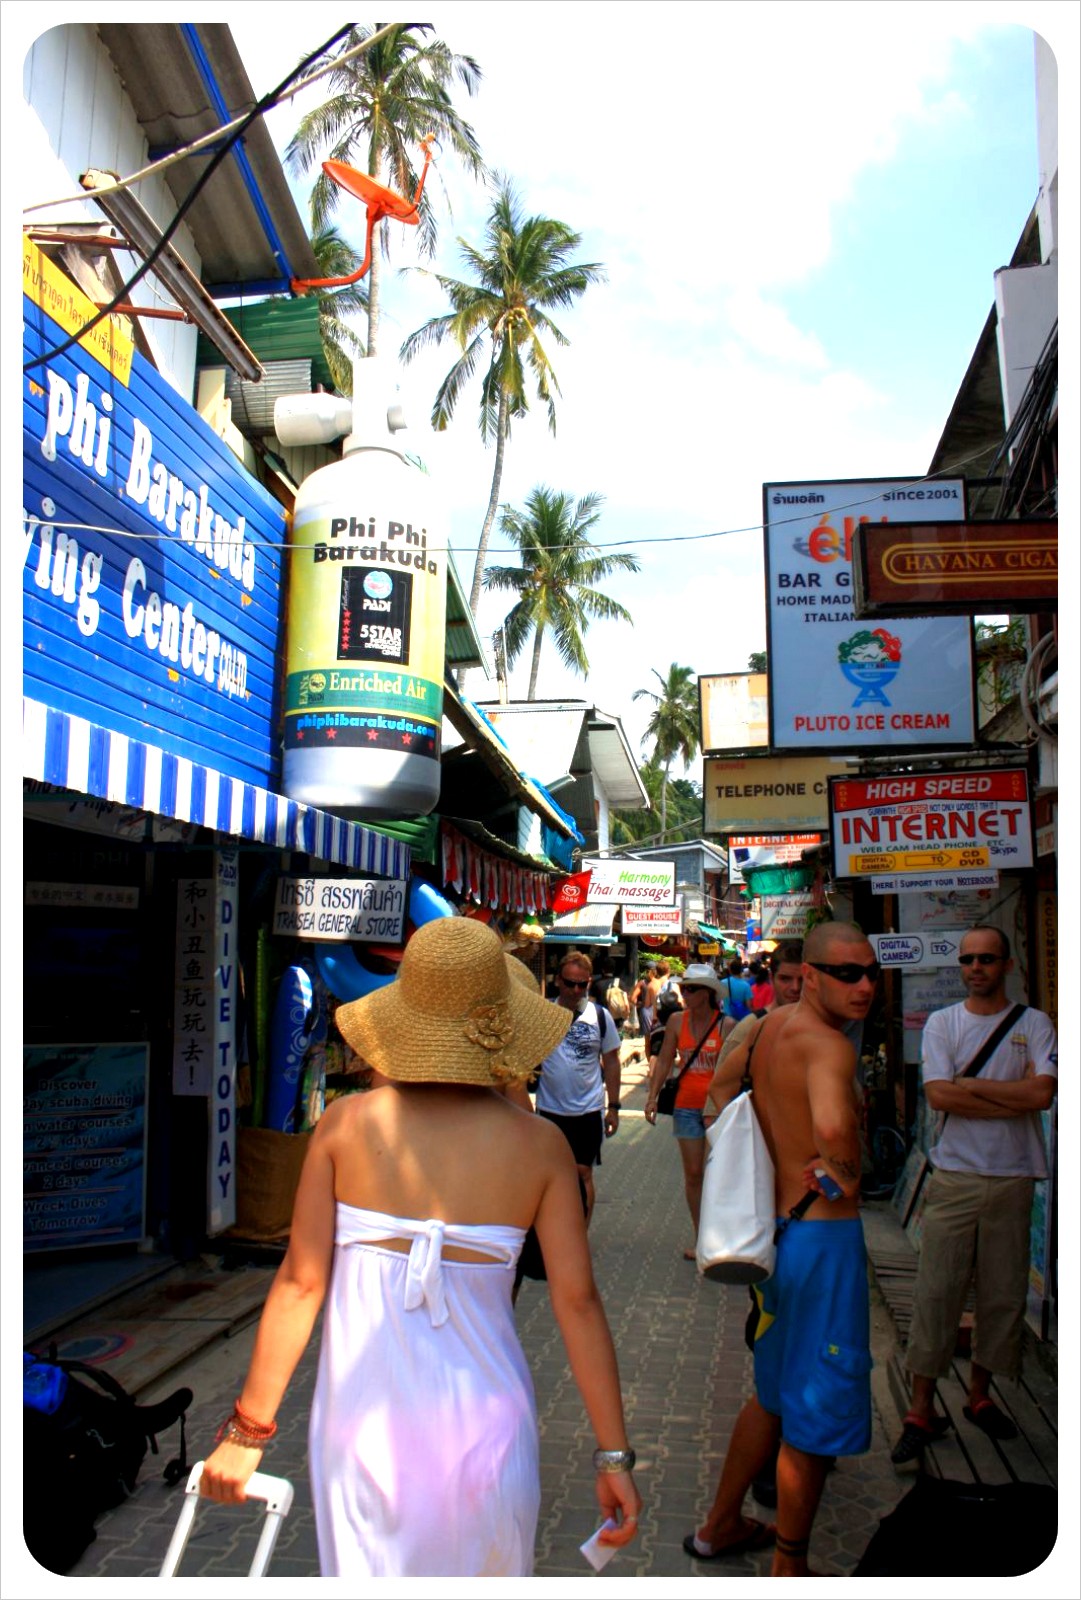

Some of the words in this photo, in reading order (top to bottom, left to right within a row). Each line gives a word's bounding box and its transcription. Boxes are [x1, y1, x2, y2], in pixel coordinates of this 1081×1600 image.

[41, 369, 112, 477] phi
[126, 417, 256, 592] Barakuda
[331, 517, 376, 539] Phi
[388, 521, 427, 548] Phi
[314, 541, 438, 576] Barakuda
[905, 553, 995, 571] HAVANA
[778, 573, 822, 588] BAR
[363, 598, 392, 613] PADI
[776, 595, 816, 606] HOME
[820, 595, 855, 605] MAD
[123, 557, 220, 683] Center
[329, 671, 402, 695] Enriched
[406, 677, 427, 701] Air
[296, 713, 435, 739] phiphibarakuda.com
[794, 714, 850, 732] PLUTO
[855, 714, 884, 730] ICE
[891, 713, 950, 730] CREAM
[716, 782, 806, 799] TELEPHONE
[866, 780, 916, 799] HIGH
[924, 776, 992, 796] SPEED
[841, 808, 1023, 845] INTERNET
[860, 846, 882, 854] WEB
[886, 845, 909, 853] CAM
[913, 843, 940, 851] HEAD
[961, 850, 981, 858] CD
[990, 844, 1018, 856] Skype
[931, 855, 944, 863] TO
[959, 858, 986, 867] DVD
[861, 863, 890, 871] CAMERA
[618, 870, 672, 888] Harmony
[935, 878, 954, 886] YOUR
[588, 882, 614, 896] Thai
[617, 884, 671, 902] massage
[628, 912, 651, 920] GUEST
[653, 912, 678, 920] HOUSE
[319, 913, 362, 935] GENERAL
[366, 917, 399, 937] STORE
[880, 940, 911, 950] DIGITAL
[934, 944, 948, 952] TO
[219, 900, 232, 1022] DIVE
[881, 951, 915, 961] CAMERA
[1044, 897, 1058, 1020] ACCOMMODATIO
[39, 1079, 98, 1091] Discover
[49, 1097, 90, 1108] scuba
[93, 1095, 133, 1107] diving
[36, 1120, 76, 1132] water
[77, 1117, 131, 1129] courses
[217, 1041, 232, 1199] TODAY
[75, 1155, 129, 1170] courses
[56, 1174, 88, 1189] days
[70, 1196, 108, 1210] Dives
[30, 1214, 100, 1231] Tomorrow
